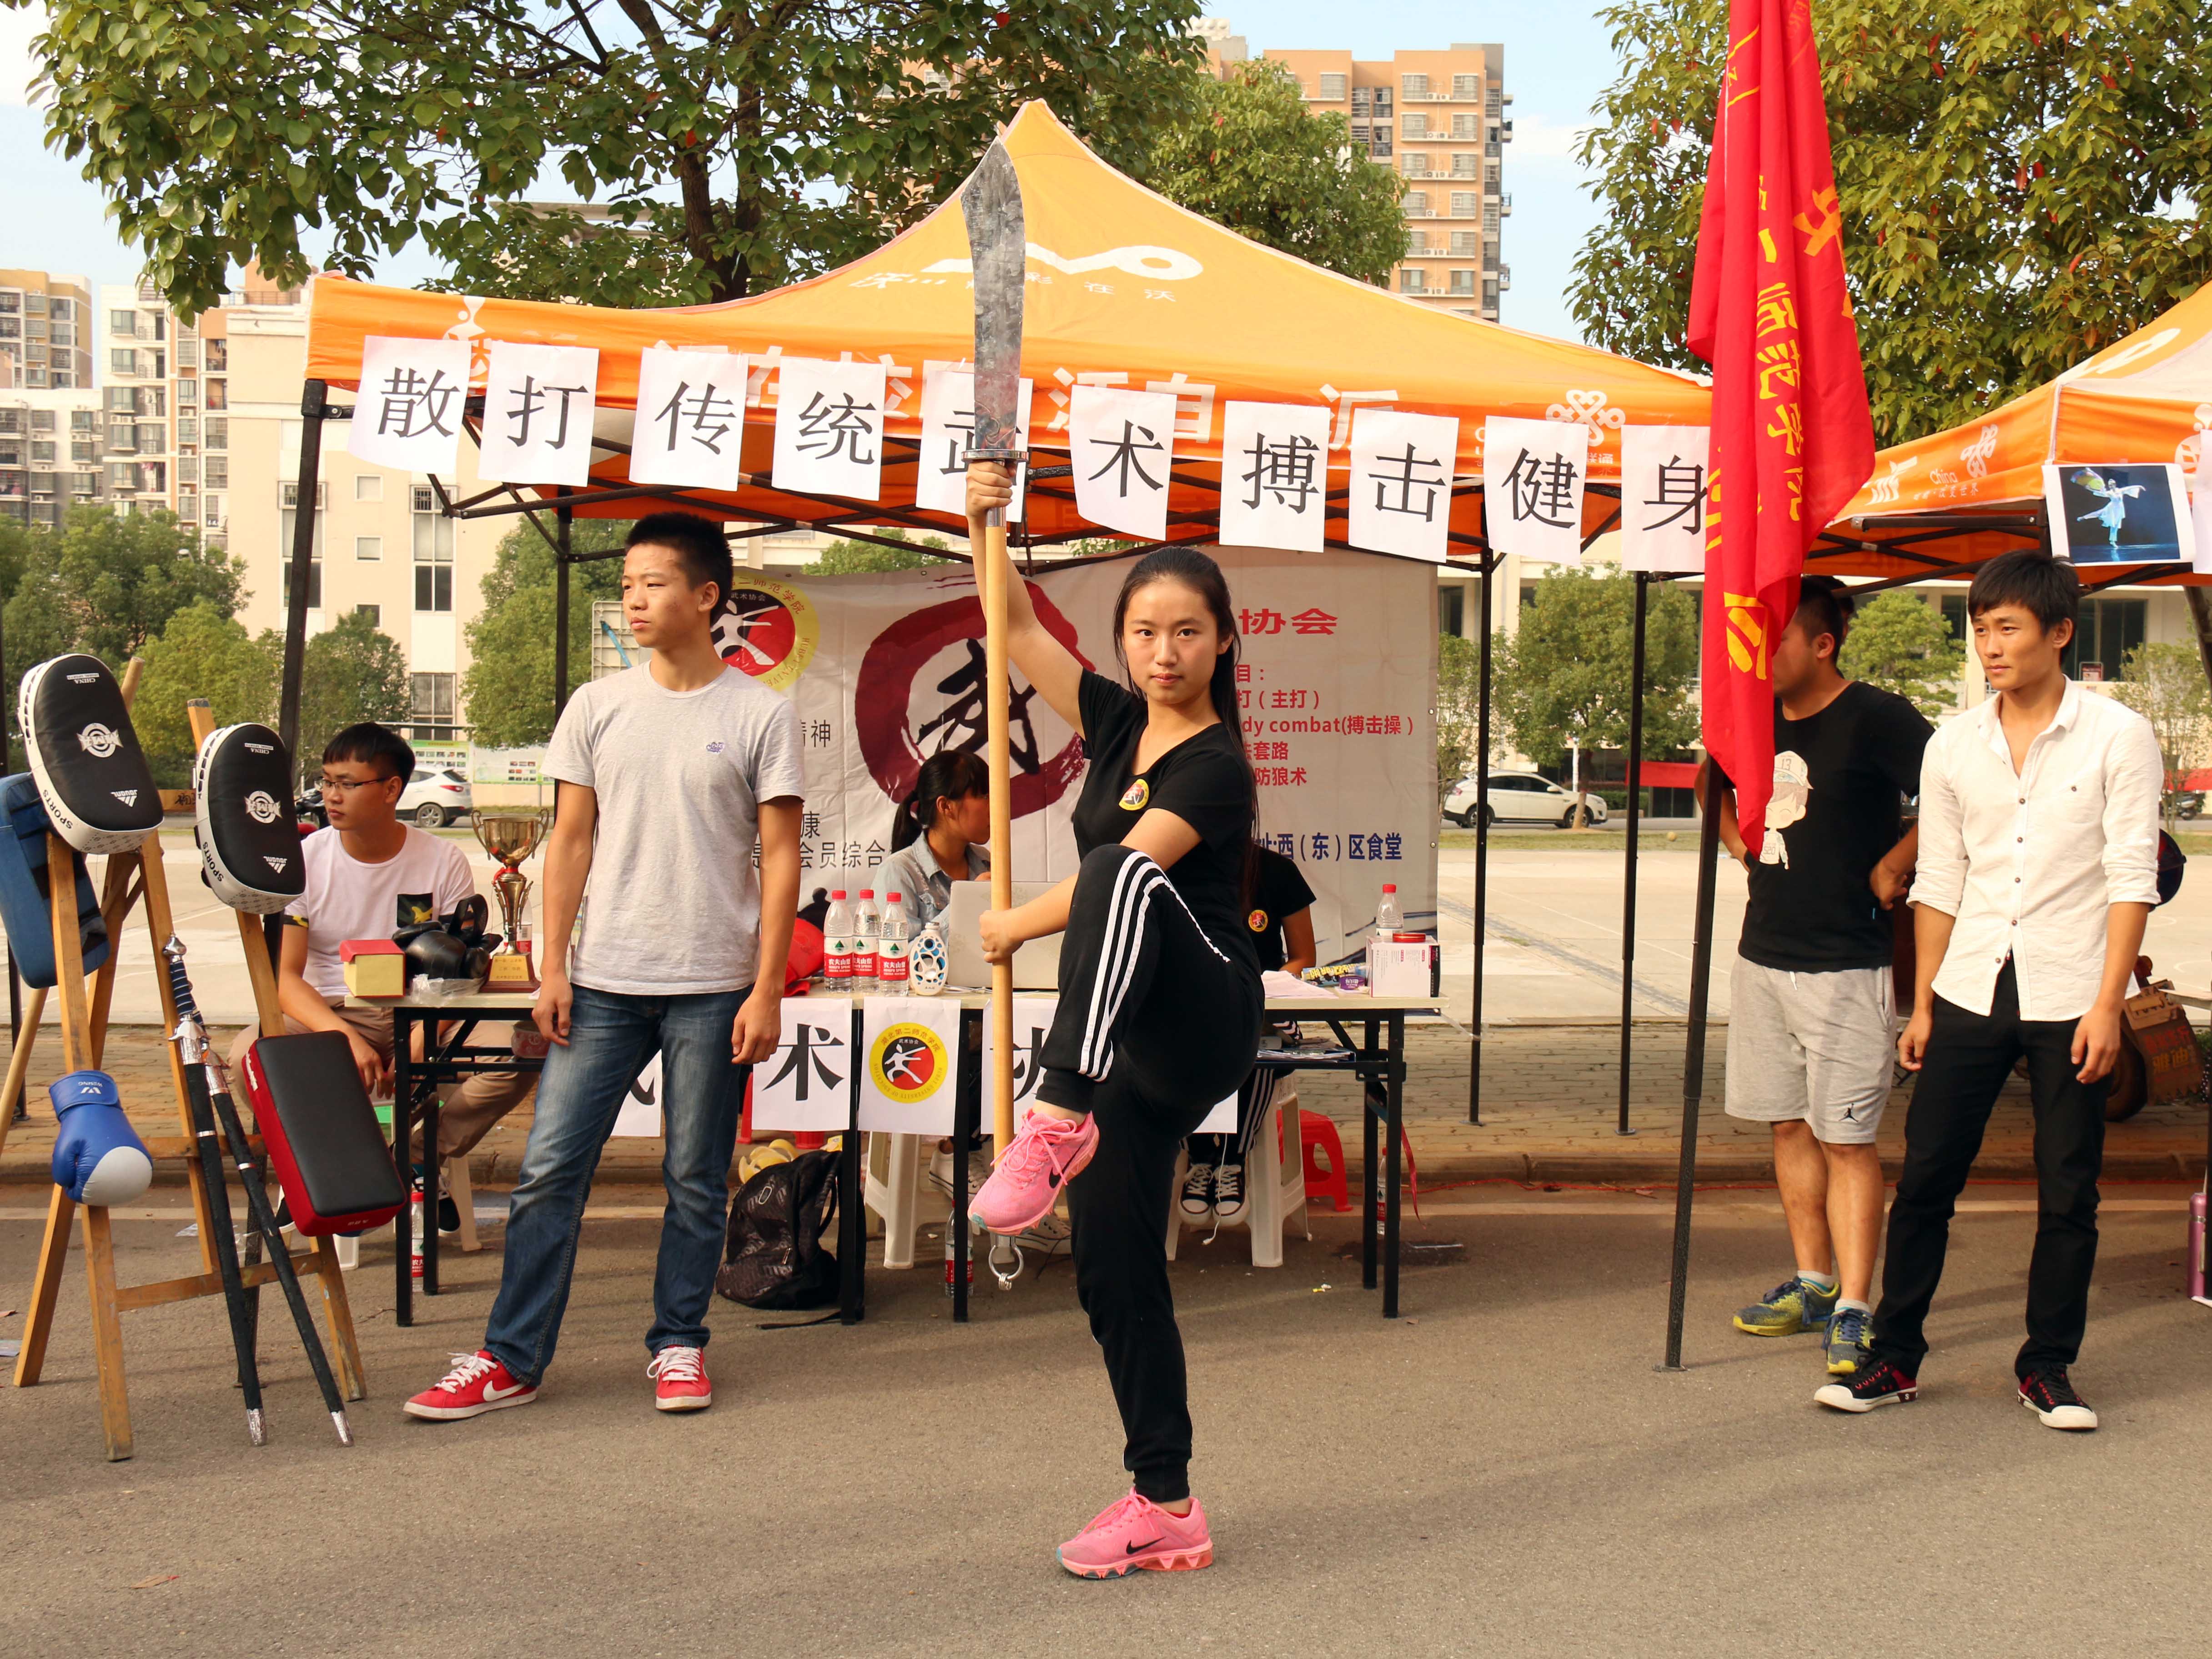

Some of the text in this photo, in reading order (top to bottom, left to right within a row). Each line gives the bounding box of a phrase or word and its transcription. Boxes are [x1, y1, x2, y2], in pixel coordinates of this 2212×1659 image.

[1929, 468, 1958, 485] China
[732, 576, 804, 614] 二师范学院
[1238, 608, 1338, 635] 协会
[43, 789, 73, 829] SPORTS
[203, 842, 224, 881] SPORTS
[881, 1028, 941, 1053] 湖北第二师范学院
